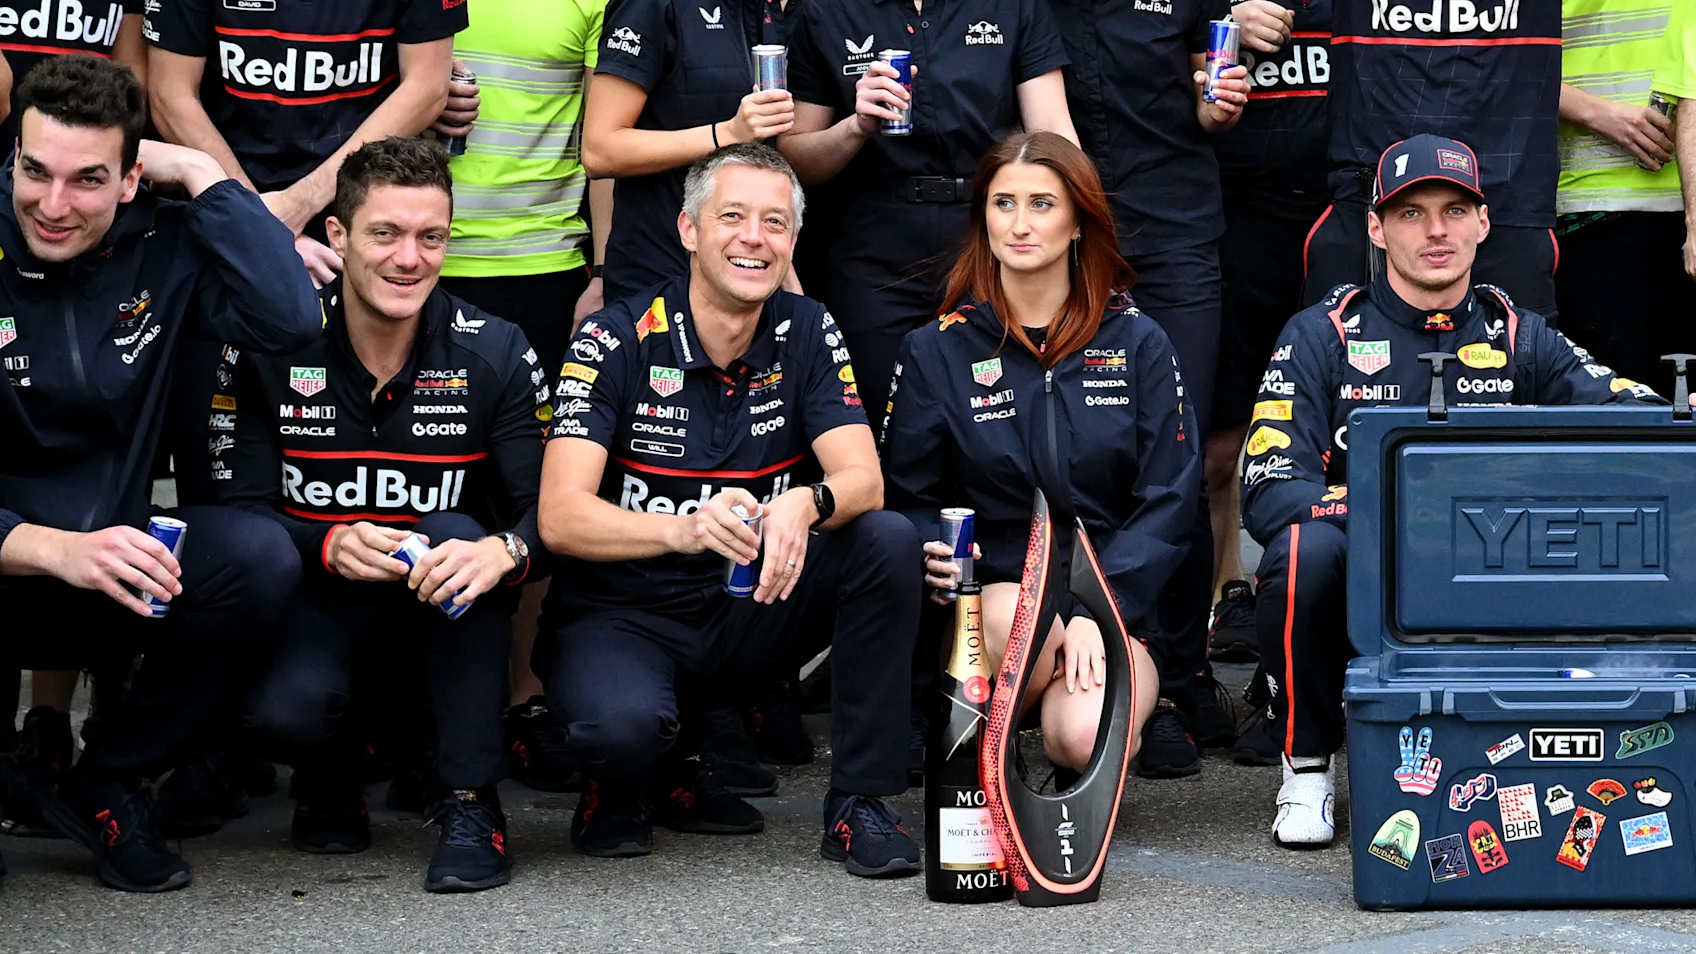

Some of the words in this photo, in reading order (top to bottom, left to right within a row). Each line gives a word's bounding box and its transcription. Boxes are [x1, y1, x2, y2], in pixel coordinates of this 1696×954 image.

[238, 0, 261, 8] DAVID
[1134, 0, 1151, 12] Red
[1152, 1, 1173, 15] Bull
[965, 34, 981, 45] Red
[982, 34, 1003, 45] Bull
[219, 40, 295, 92] Red
[303, 43, 383, 92] Bull
[1394, 153, 1410, 177] 1
[579, 321, 621, 352] Mobil
[676, 322, 693, 363] 1Password
[1084, 349, 1126, 358] ORACLE
[1351, 342, 1386, 355] TAG
[974, 360, 1000, 373] TAG
[1351, 355, 1388, 372] HEUER
[293, 368, 324, 380] TAG
[654, 368, 682, 380] TAG
[291, 379, 326, 393] HEUER
[556, 380, 592, 394] HRC
[651, 380, 683, 394] HEUER
[1082, 380, 1128, 388] HONDA
[1339, 384, 1382, 400] Mobil
[970, 392, 1003, 409] Mobil
[1095, 395, 1129, 407] Gate.io
[280, 405, 321, 419] Mobil
[412, 405, 468, 414] HONDA
[635, 402, 675, 419] Mobil
[973, 408, 1016, 423] ORACLE
[559, 418, 581, 426] AVA
[280, 426, 336, 436] ORACLE
[554, 426, 589, 436] TRADE
[632, 422, 687, 437] ORACLE
[648, 444, 667, 452] WILL
[282, 461, 367, 507] Red
[376, 468, 465, 512] Bull
[1311, 504, 1335, 518] Red
[1461, 507, 1661, 568] YETI
[967, 607, 980, 666] MOËT
[1535, 735, 1597, 755] YETI
[956, 791, 987, 806] MO
[948, 828, 972, 836] MOËT
[1505, 820, 1540, 839] BHR
[1371, 846, 1410, 867] BUDAPEST
[956, 870, 1009, 889] MOËT
